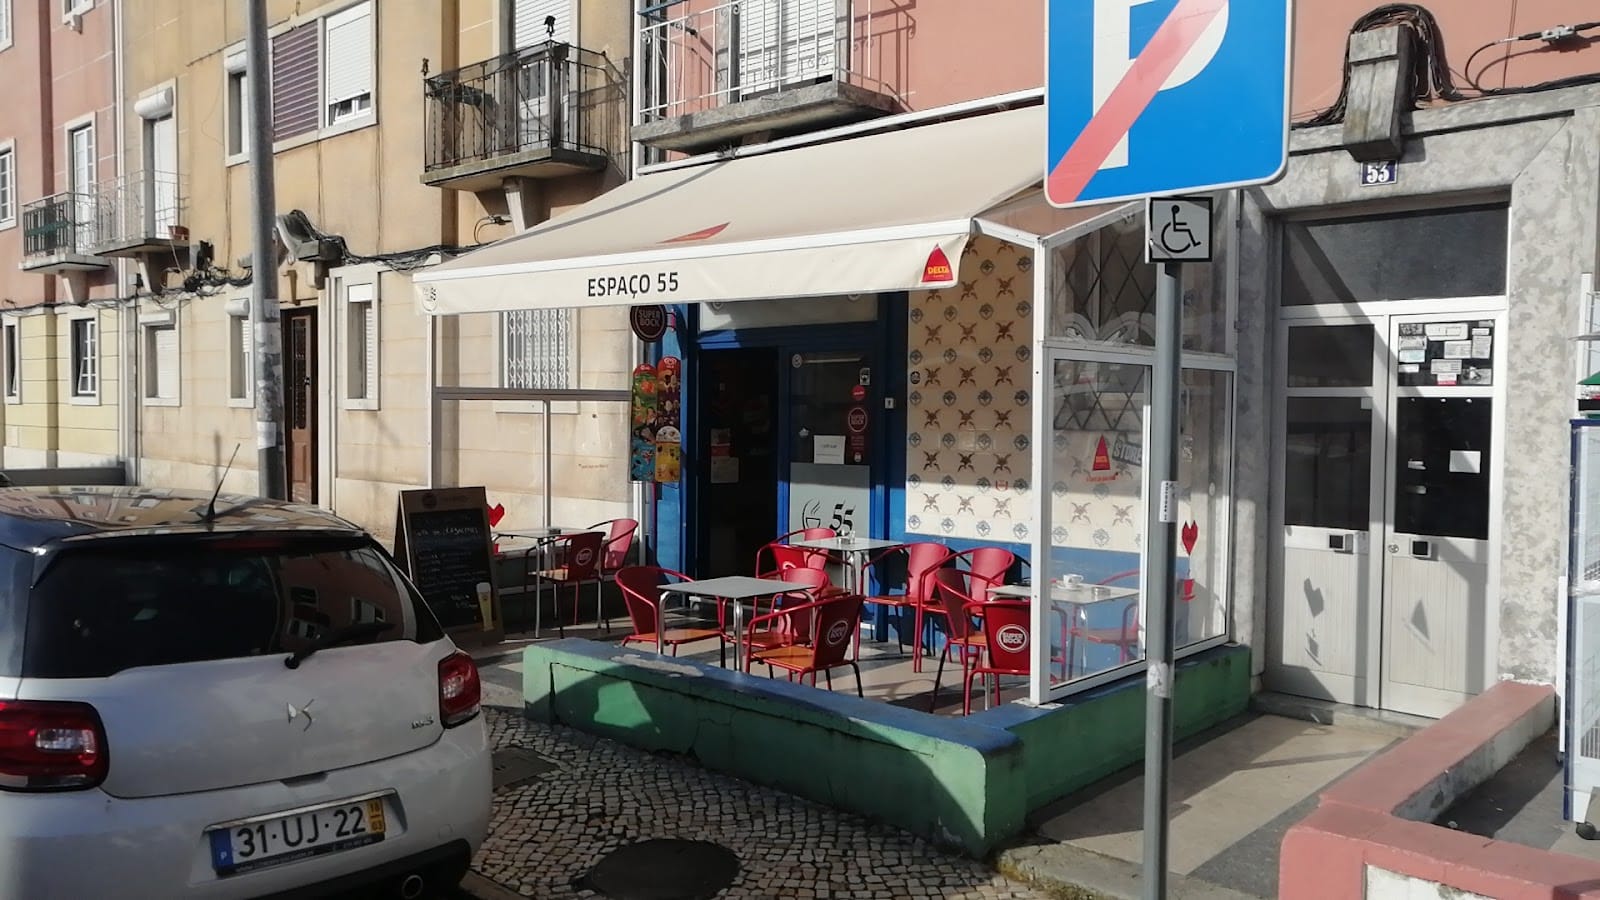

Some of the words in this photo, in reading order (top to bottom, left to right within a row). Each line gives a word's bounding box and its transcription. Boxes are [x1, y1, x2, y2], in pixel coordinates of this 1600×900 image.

[1093, 0, 1229, 169] P
[1367, 160, 1390, 184] 53
[927, 265, 949, 274] DELTA
[587, 274, 651, 299] ESPAÇO
[657, 272, 679, 292] 55
[638, 309, 661, 318] SUPER
[829, 499, 856, 536] 55
[220, 851, 227, 860] P
